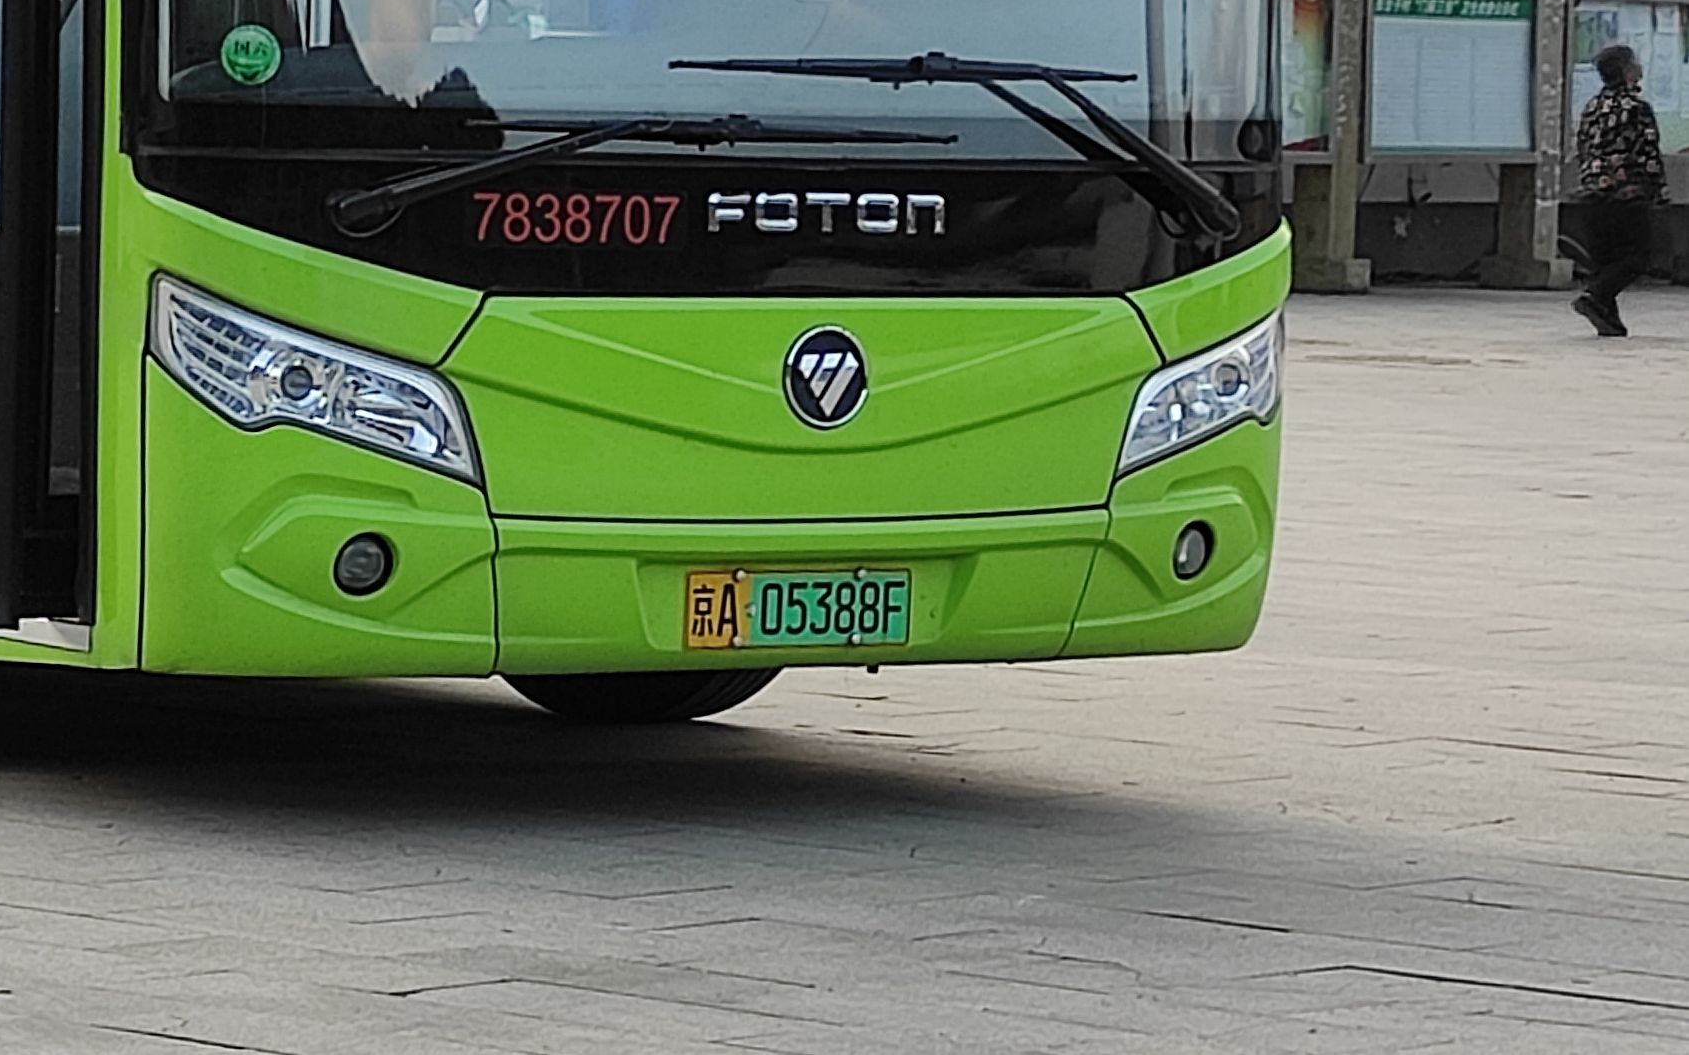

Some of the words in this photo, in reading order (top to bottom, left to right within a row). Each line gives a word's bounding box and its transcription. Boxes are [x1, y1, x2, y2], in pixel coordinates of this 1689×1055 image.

[473, 192, 681, 244] 7838707
[707, 191, 946, 235] FOTON
[692, 583, 740, 636] 京A
[761, 581, 906, 635] 05388F
